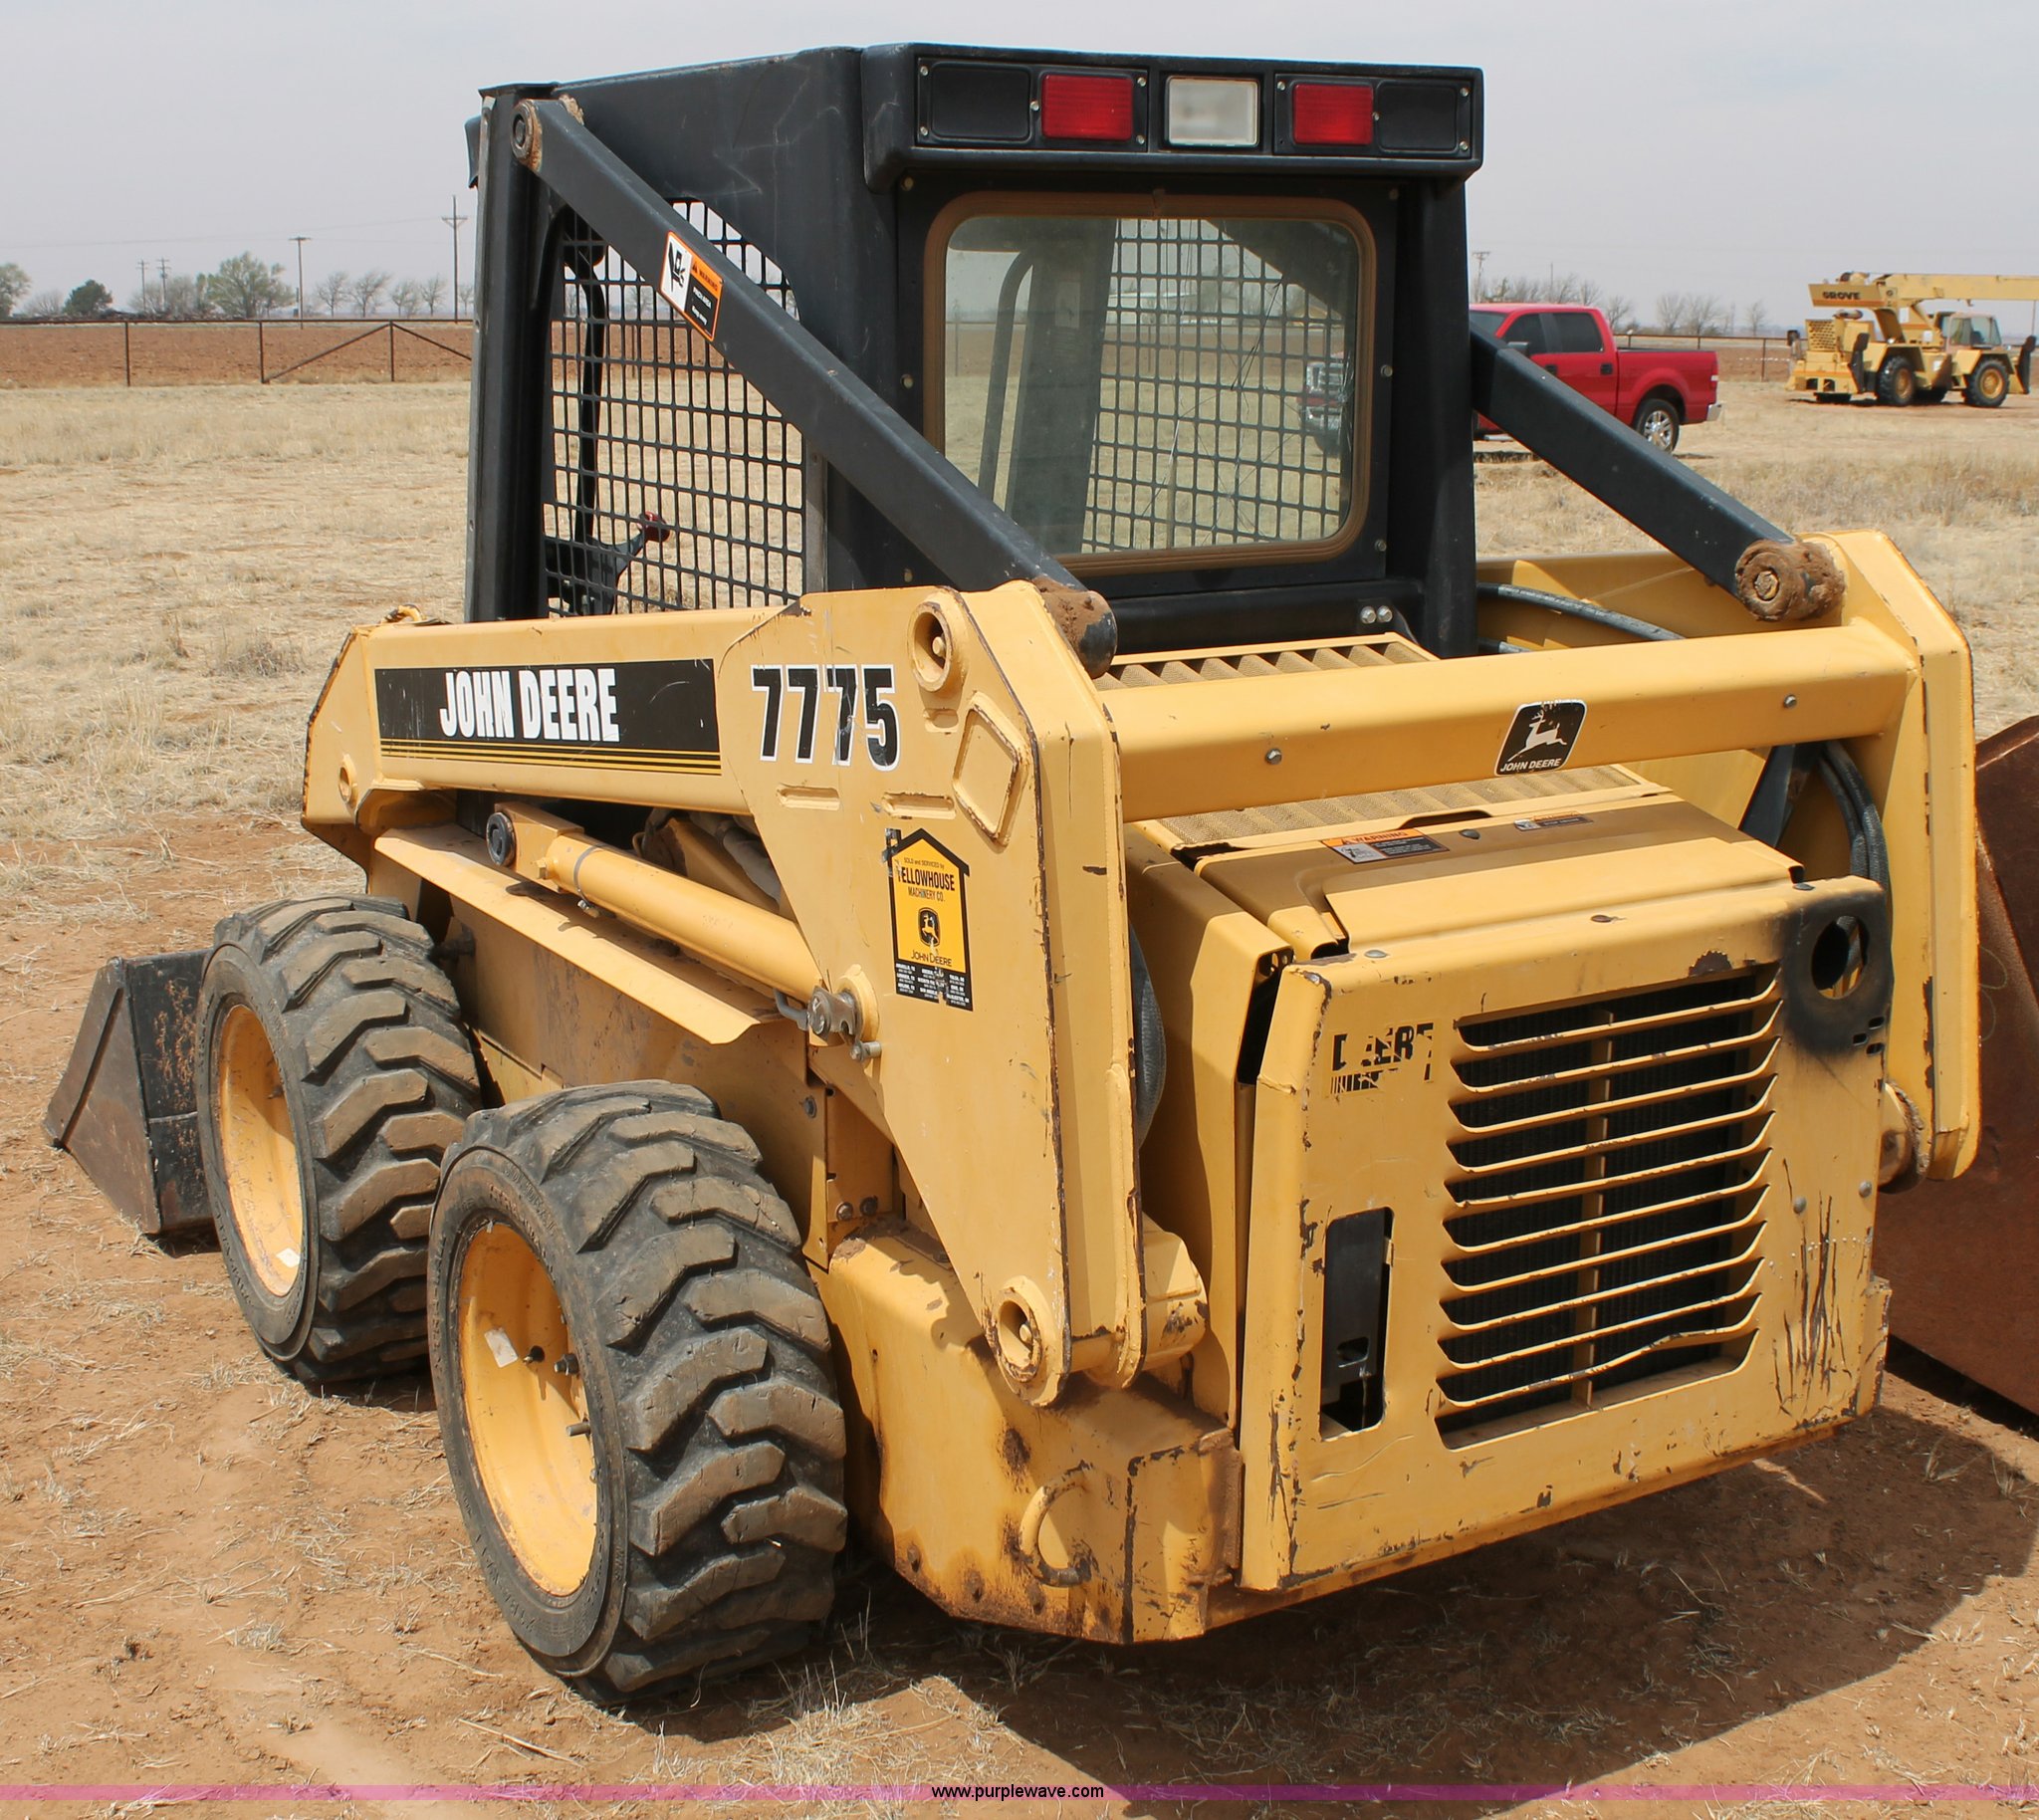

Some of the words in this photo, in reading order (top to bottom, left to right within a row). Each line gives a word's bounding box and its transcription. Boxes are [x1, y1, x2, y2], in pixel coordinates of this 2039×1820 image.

[1822, 291, 1861, 301] GROVE
[439, 669, 515, 739] JOHN
[518, 667, 620, 743] DEERE
[750, 663, 901, 772] 7775
[1499, 761, 1529, 773] JOHN
[1528, 758, 1562, 770] DEERE
[1352, 830, 1409, 844] WARNING
[910, 949, 929, 963] JOHN
[929, 953, 952, 968] DEERE
